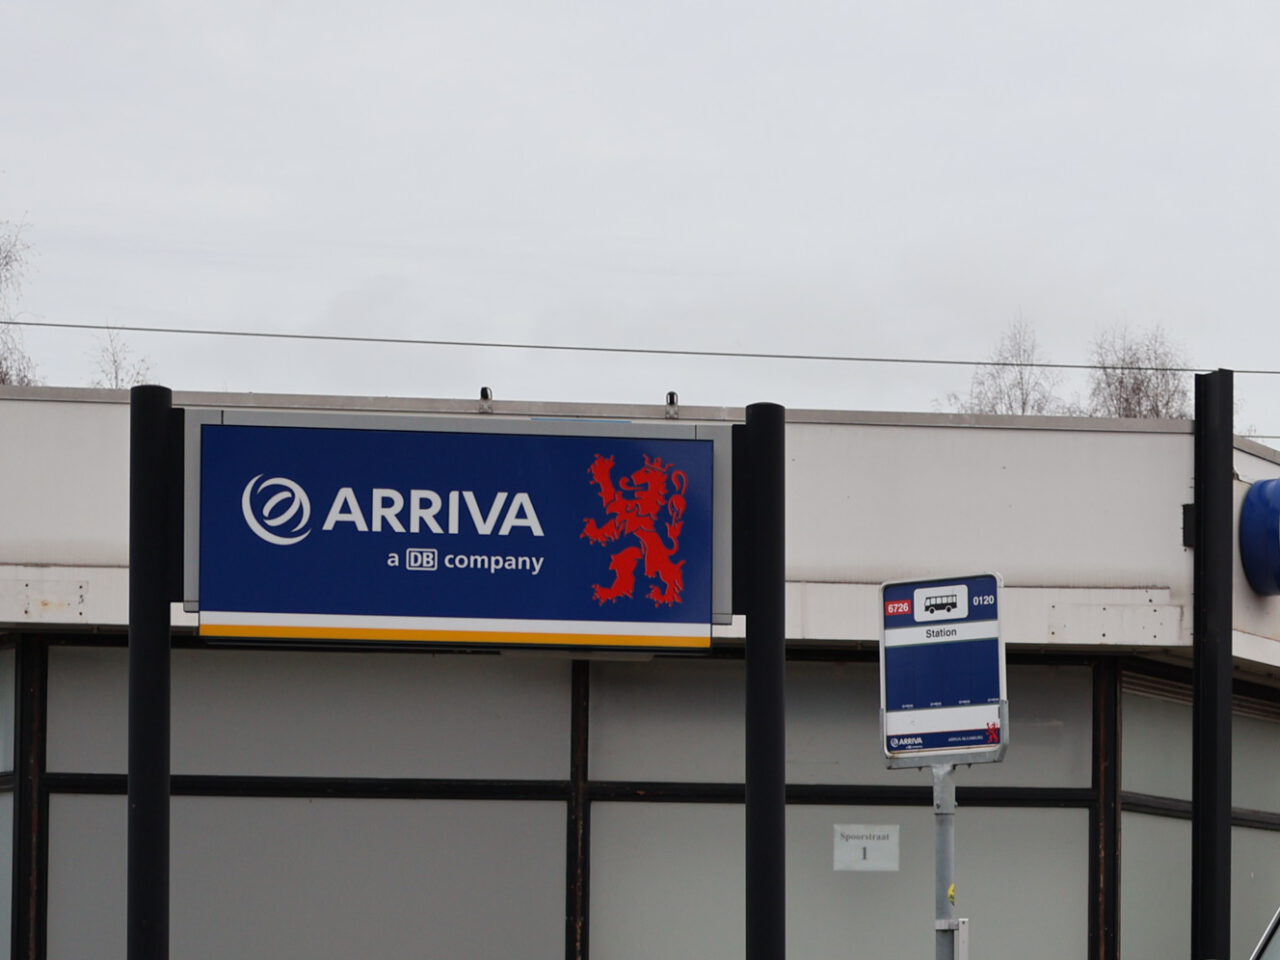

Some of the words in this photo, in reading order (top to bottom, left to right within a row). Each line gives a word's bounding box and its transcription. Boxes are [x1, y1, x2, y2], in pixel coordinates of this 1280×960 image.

[322, 487, 545, 537] ARRIVA
[386, 552, 400, 567] a
[408, 550, 436, 569] DB
[444, 553, 545, 575] company
[972, 595, 995, 606] 0120
[887, 602, 909, 614] 6726
[925, 628, 957, 639] Station
[899, 736, 923, 746] ARRIVA
